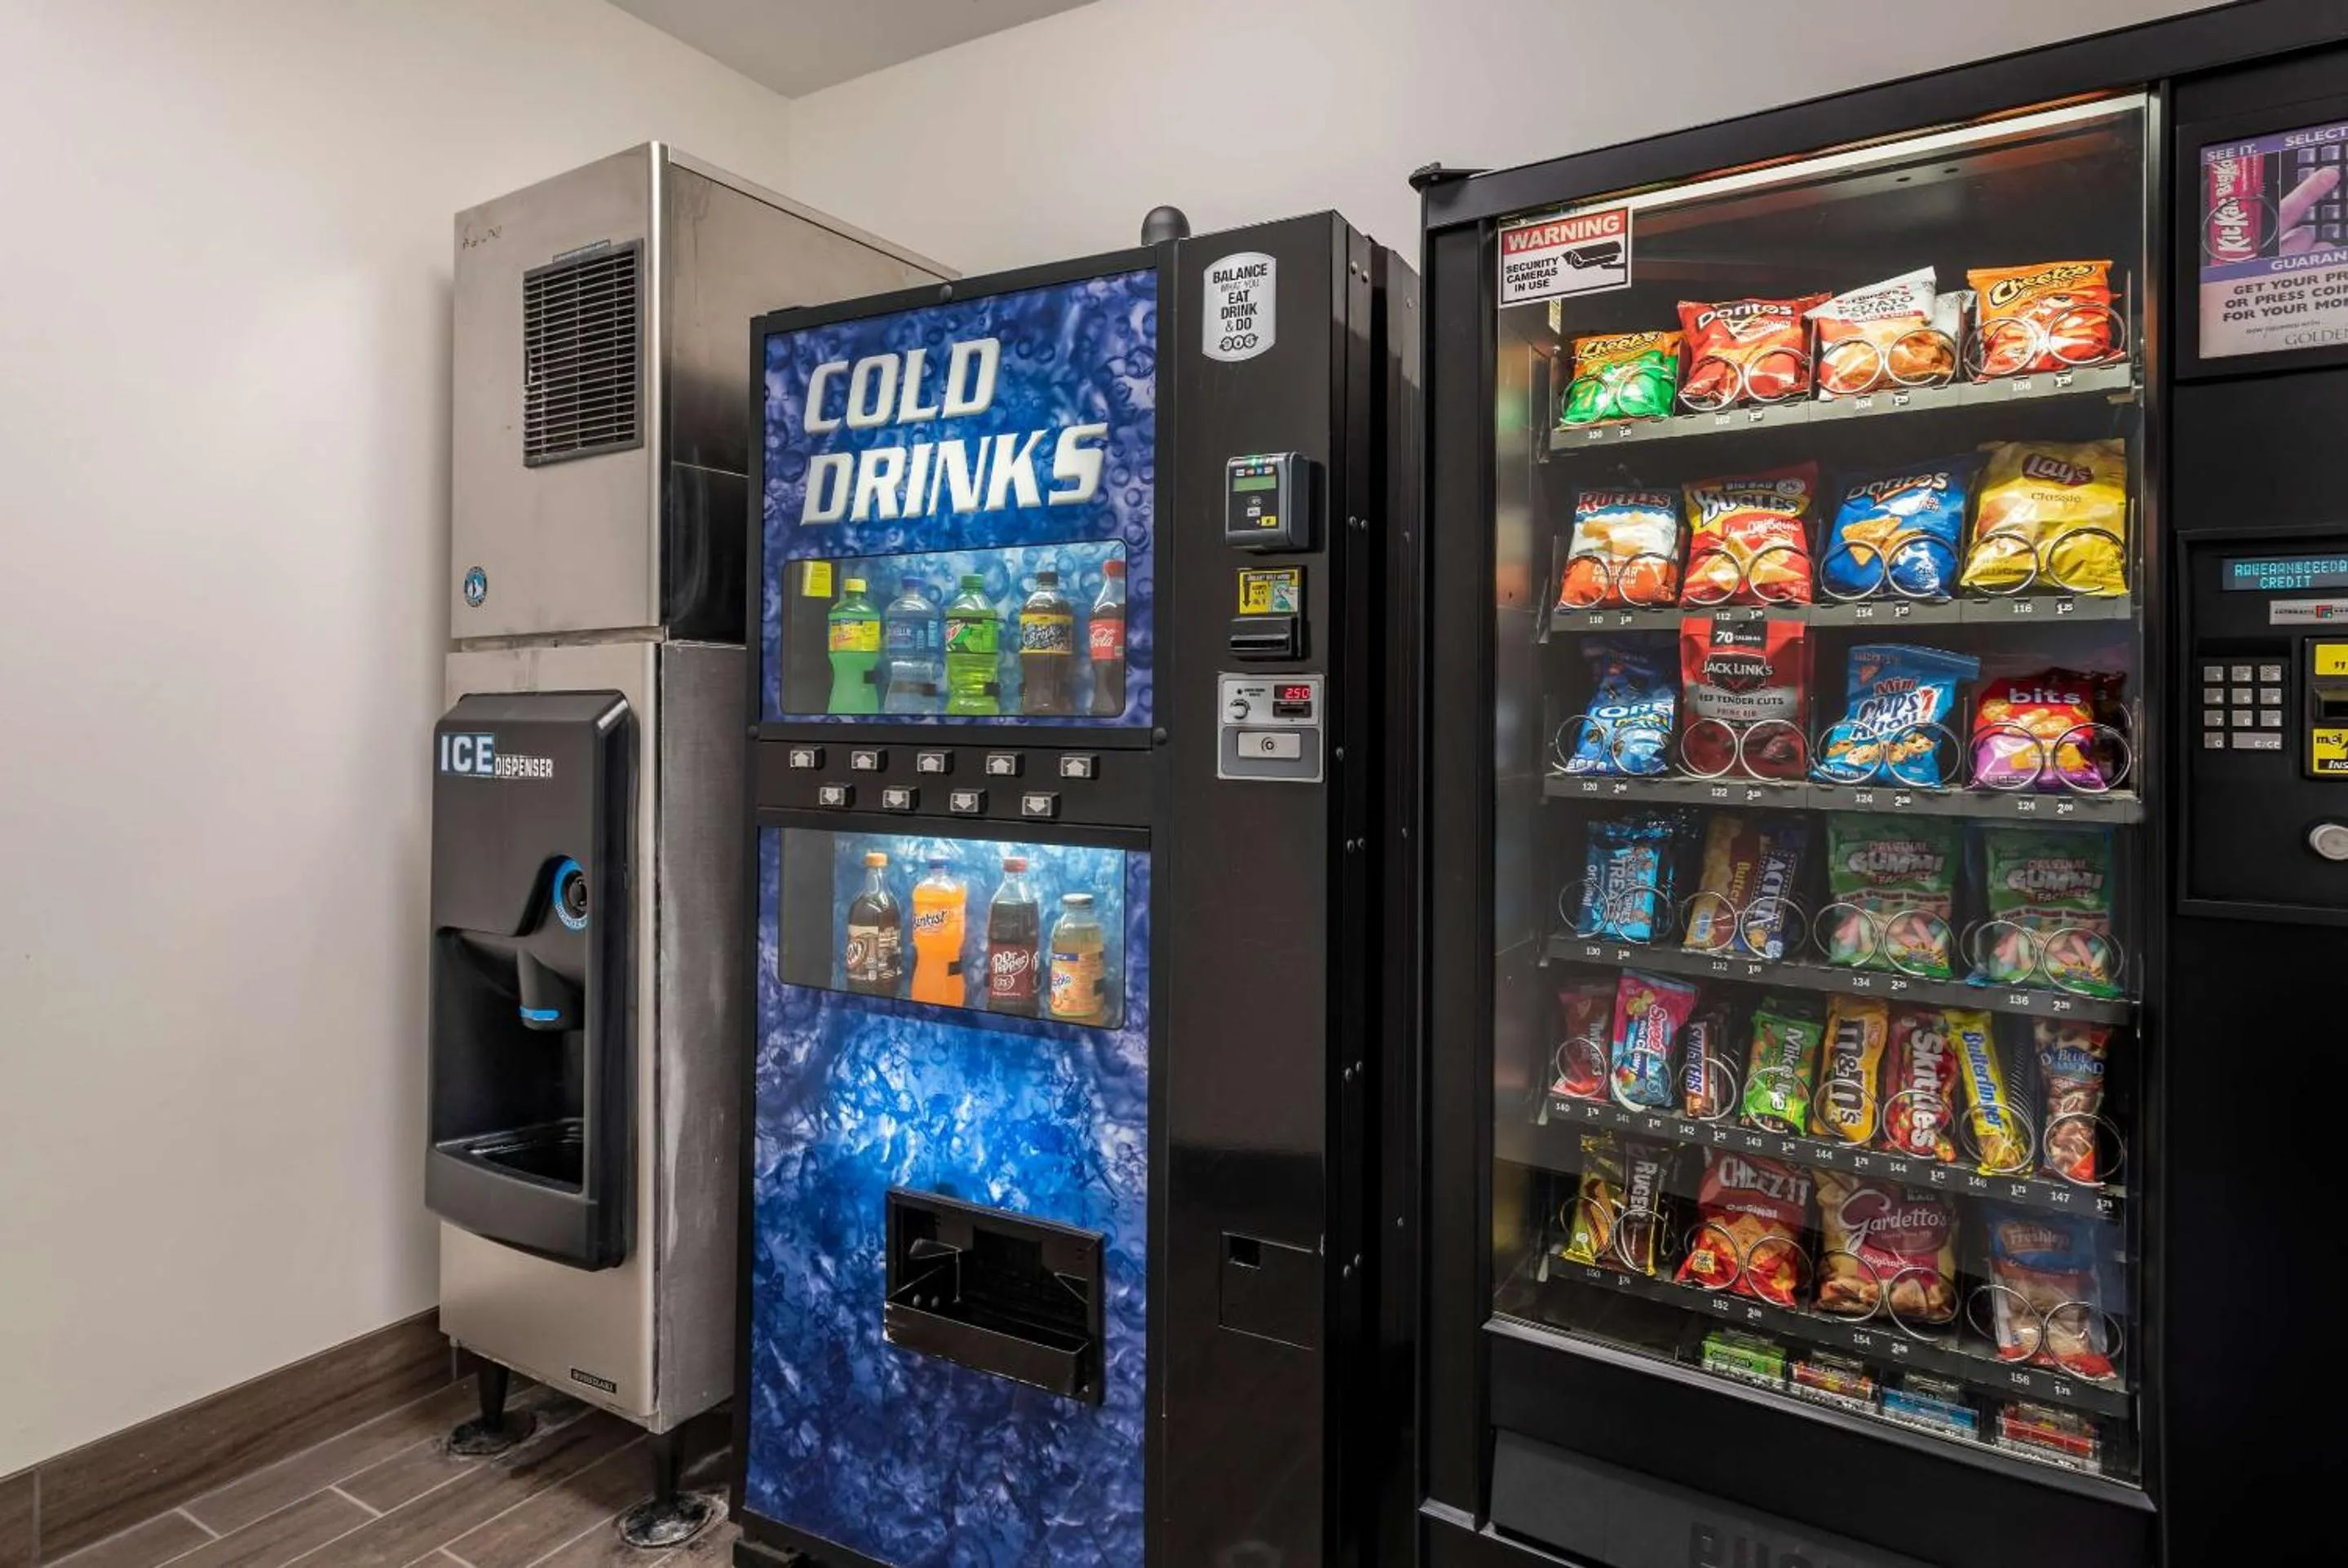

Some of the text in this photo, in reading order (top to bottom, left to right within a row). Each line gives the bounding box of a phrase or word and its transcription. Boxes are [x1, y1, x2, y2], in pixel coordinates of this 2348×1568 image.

[2285, 126, 2348, 147] SELECT
[2207, 148, 2235, 161] SEE
[1510, 214, 1620, 251] WARNING
[1506, 256, 1559, 274] SECURITY
[2271, 250, 2348, 270] GUARAN
[1213, 263, 1268, 284] BALANCE
[1506, 267, 1559, 284] CAMERAS
[1514, 278, 1550, 292] IN USE
[1988, 263, 2096, 309] Cheetos
[2234, 283, 2265, 294] GET
[2271, 275, 2319, 289] YOUR
[1228, 289, 1250, 304] EAT
[2225, 298, 2249, 308] OR
[2255, 290, 2306, 305] PRESS
[1221, 302, 1258, 320] DRINK
[1698, 303, 1793, 330] Doritos
[2223, 310, 2256, 322] FOR
[2262, 303, 2308, 317] YOUR
[1226, 317, 1252, 333] & DO
[804, 337, 1001, 435] COLD
[800, 422, 1108, 527] DRINKS
[2026, 454, 2094, 484] Lay's
[1846, 471, 1951, 501] Doritos
[2260, 576, 2312, 589] CREDIT
[1590, 616, 1604, 624] 110
[1716, 612, 1731, 621] 112
[1856, 607, 1873, 617] 114
[1716, 630, 1734, 644] 70
[1703, 660, 1733, 676] JACK
[1718, 696, 1754, 705] TENDER
[1757, 697, 1784, 705] CUTS
[2009, 687, 2082, 705] bits
[440, 735, 553, 777] ICE DISPENSER
[1582, 782, 1598, 791] 120
[1711, 788, 1728, 797] 122
[1730, 861, 1751, 903] Butter
[1853, 977, 1870, 987] 134
[2009, 994, 2030, 1005] 136
[2057, 1050, 2087, 1062] BLUE
[1962, 1031, 2003, 1129] Butterfinger
[1679, 1124, 1695, 1134] 142
[1968, 1177, 1988, 1187] 146
[2051, 1192, 2071, 1203] 147
[1713, 1299, 1728, 1310] 152
[1854, 1333, 1870, 1345] 154
